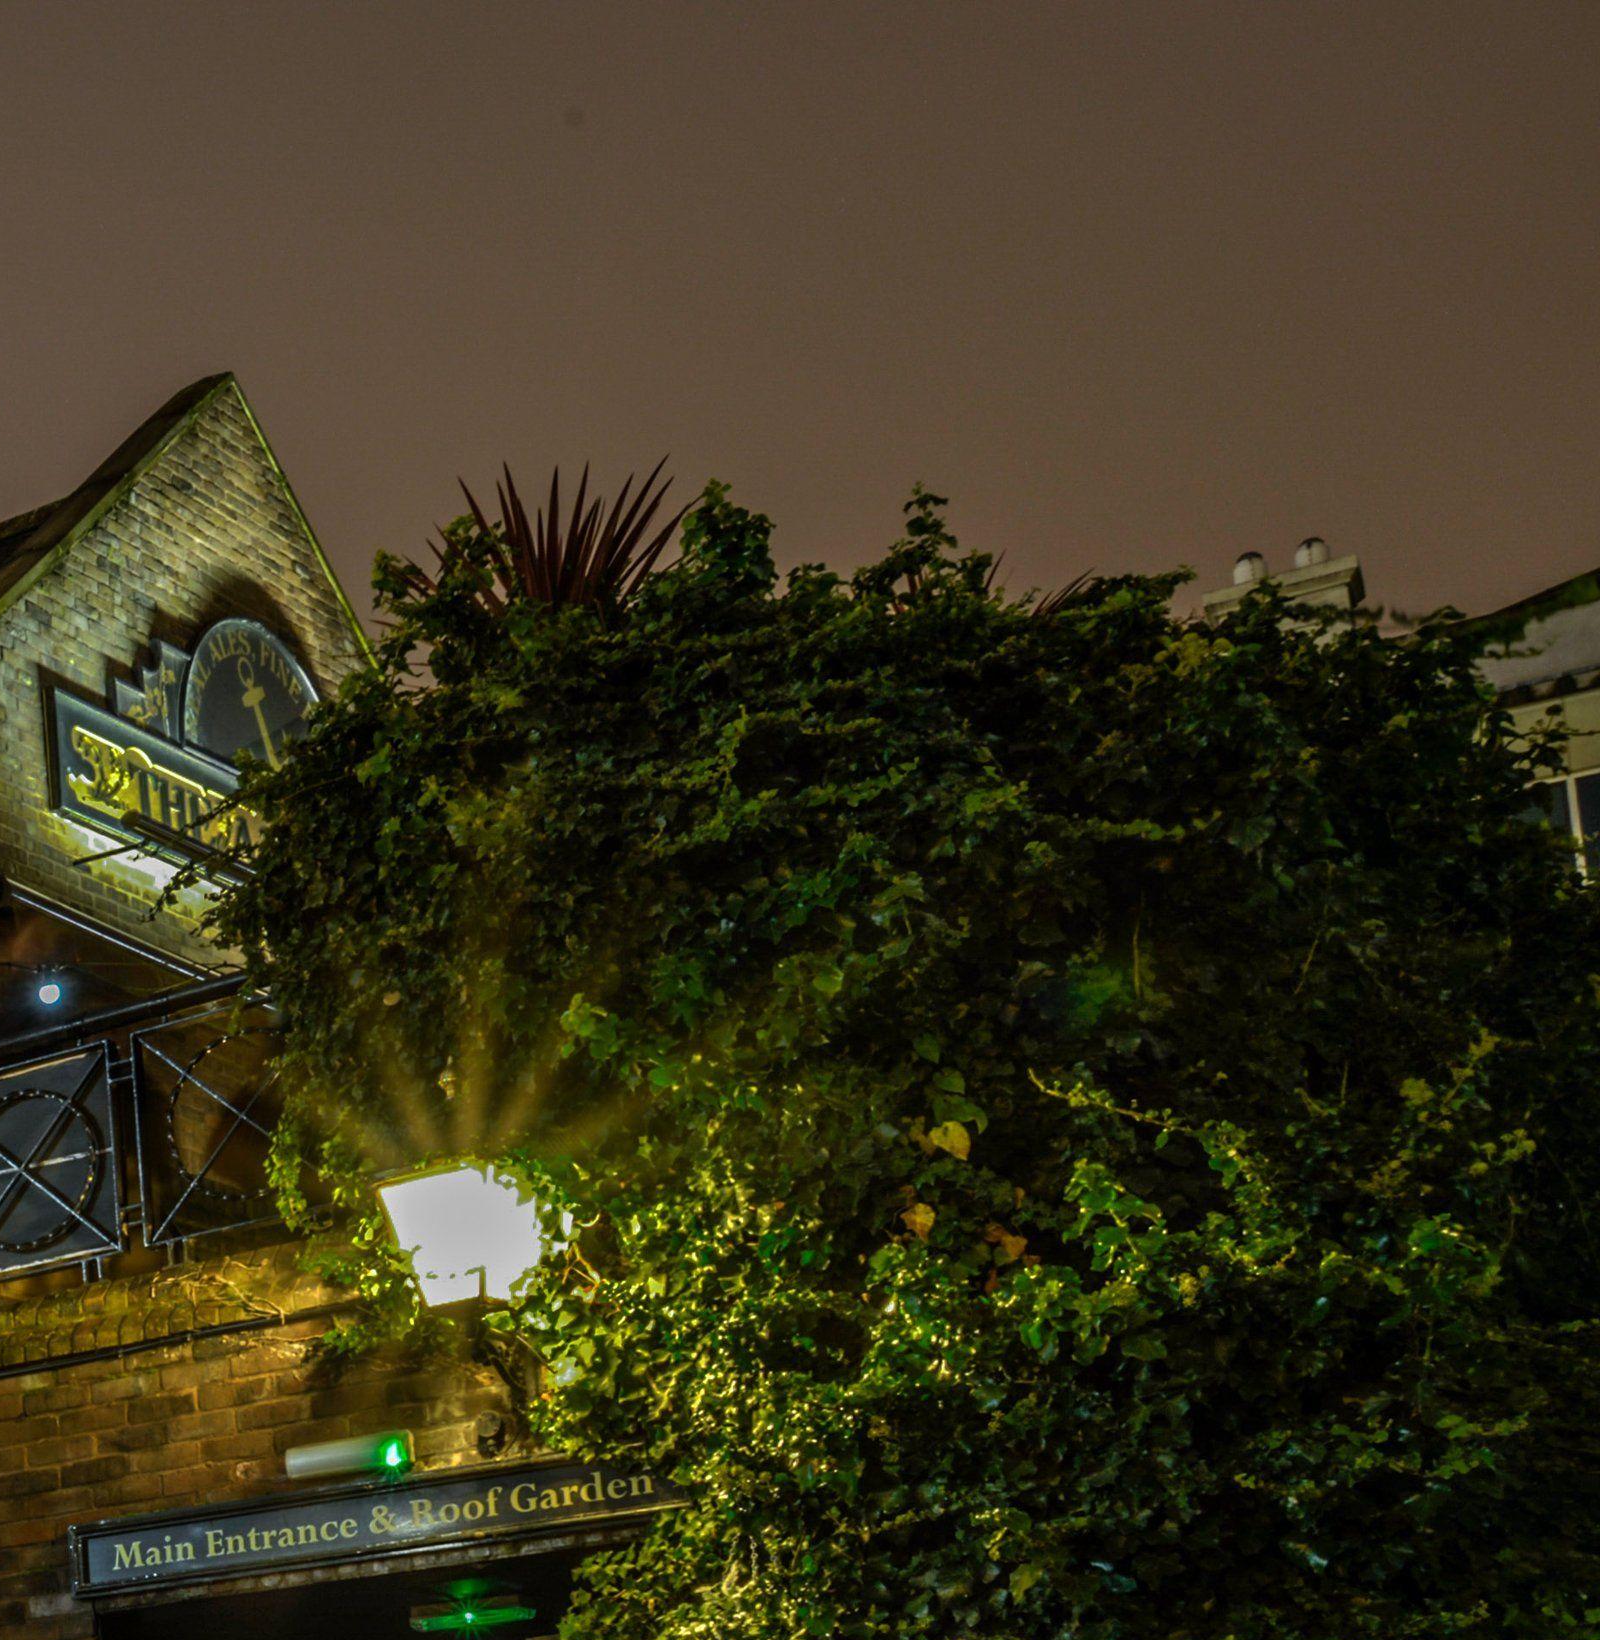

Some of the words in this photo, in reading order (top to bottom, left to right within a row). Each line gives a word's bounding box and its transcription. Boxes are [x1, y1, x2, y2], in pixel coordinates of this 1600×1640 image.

[112, 1535, 195, 1570] Main
[205, 1517, 358, 1558] Entrance
[369, 1504, 398, 1534] &
[409, 1486, 503, 1528] Roof
[509, 1470, 655, 1514] Garden
